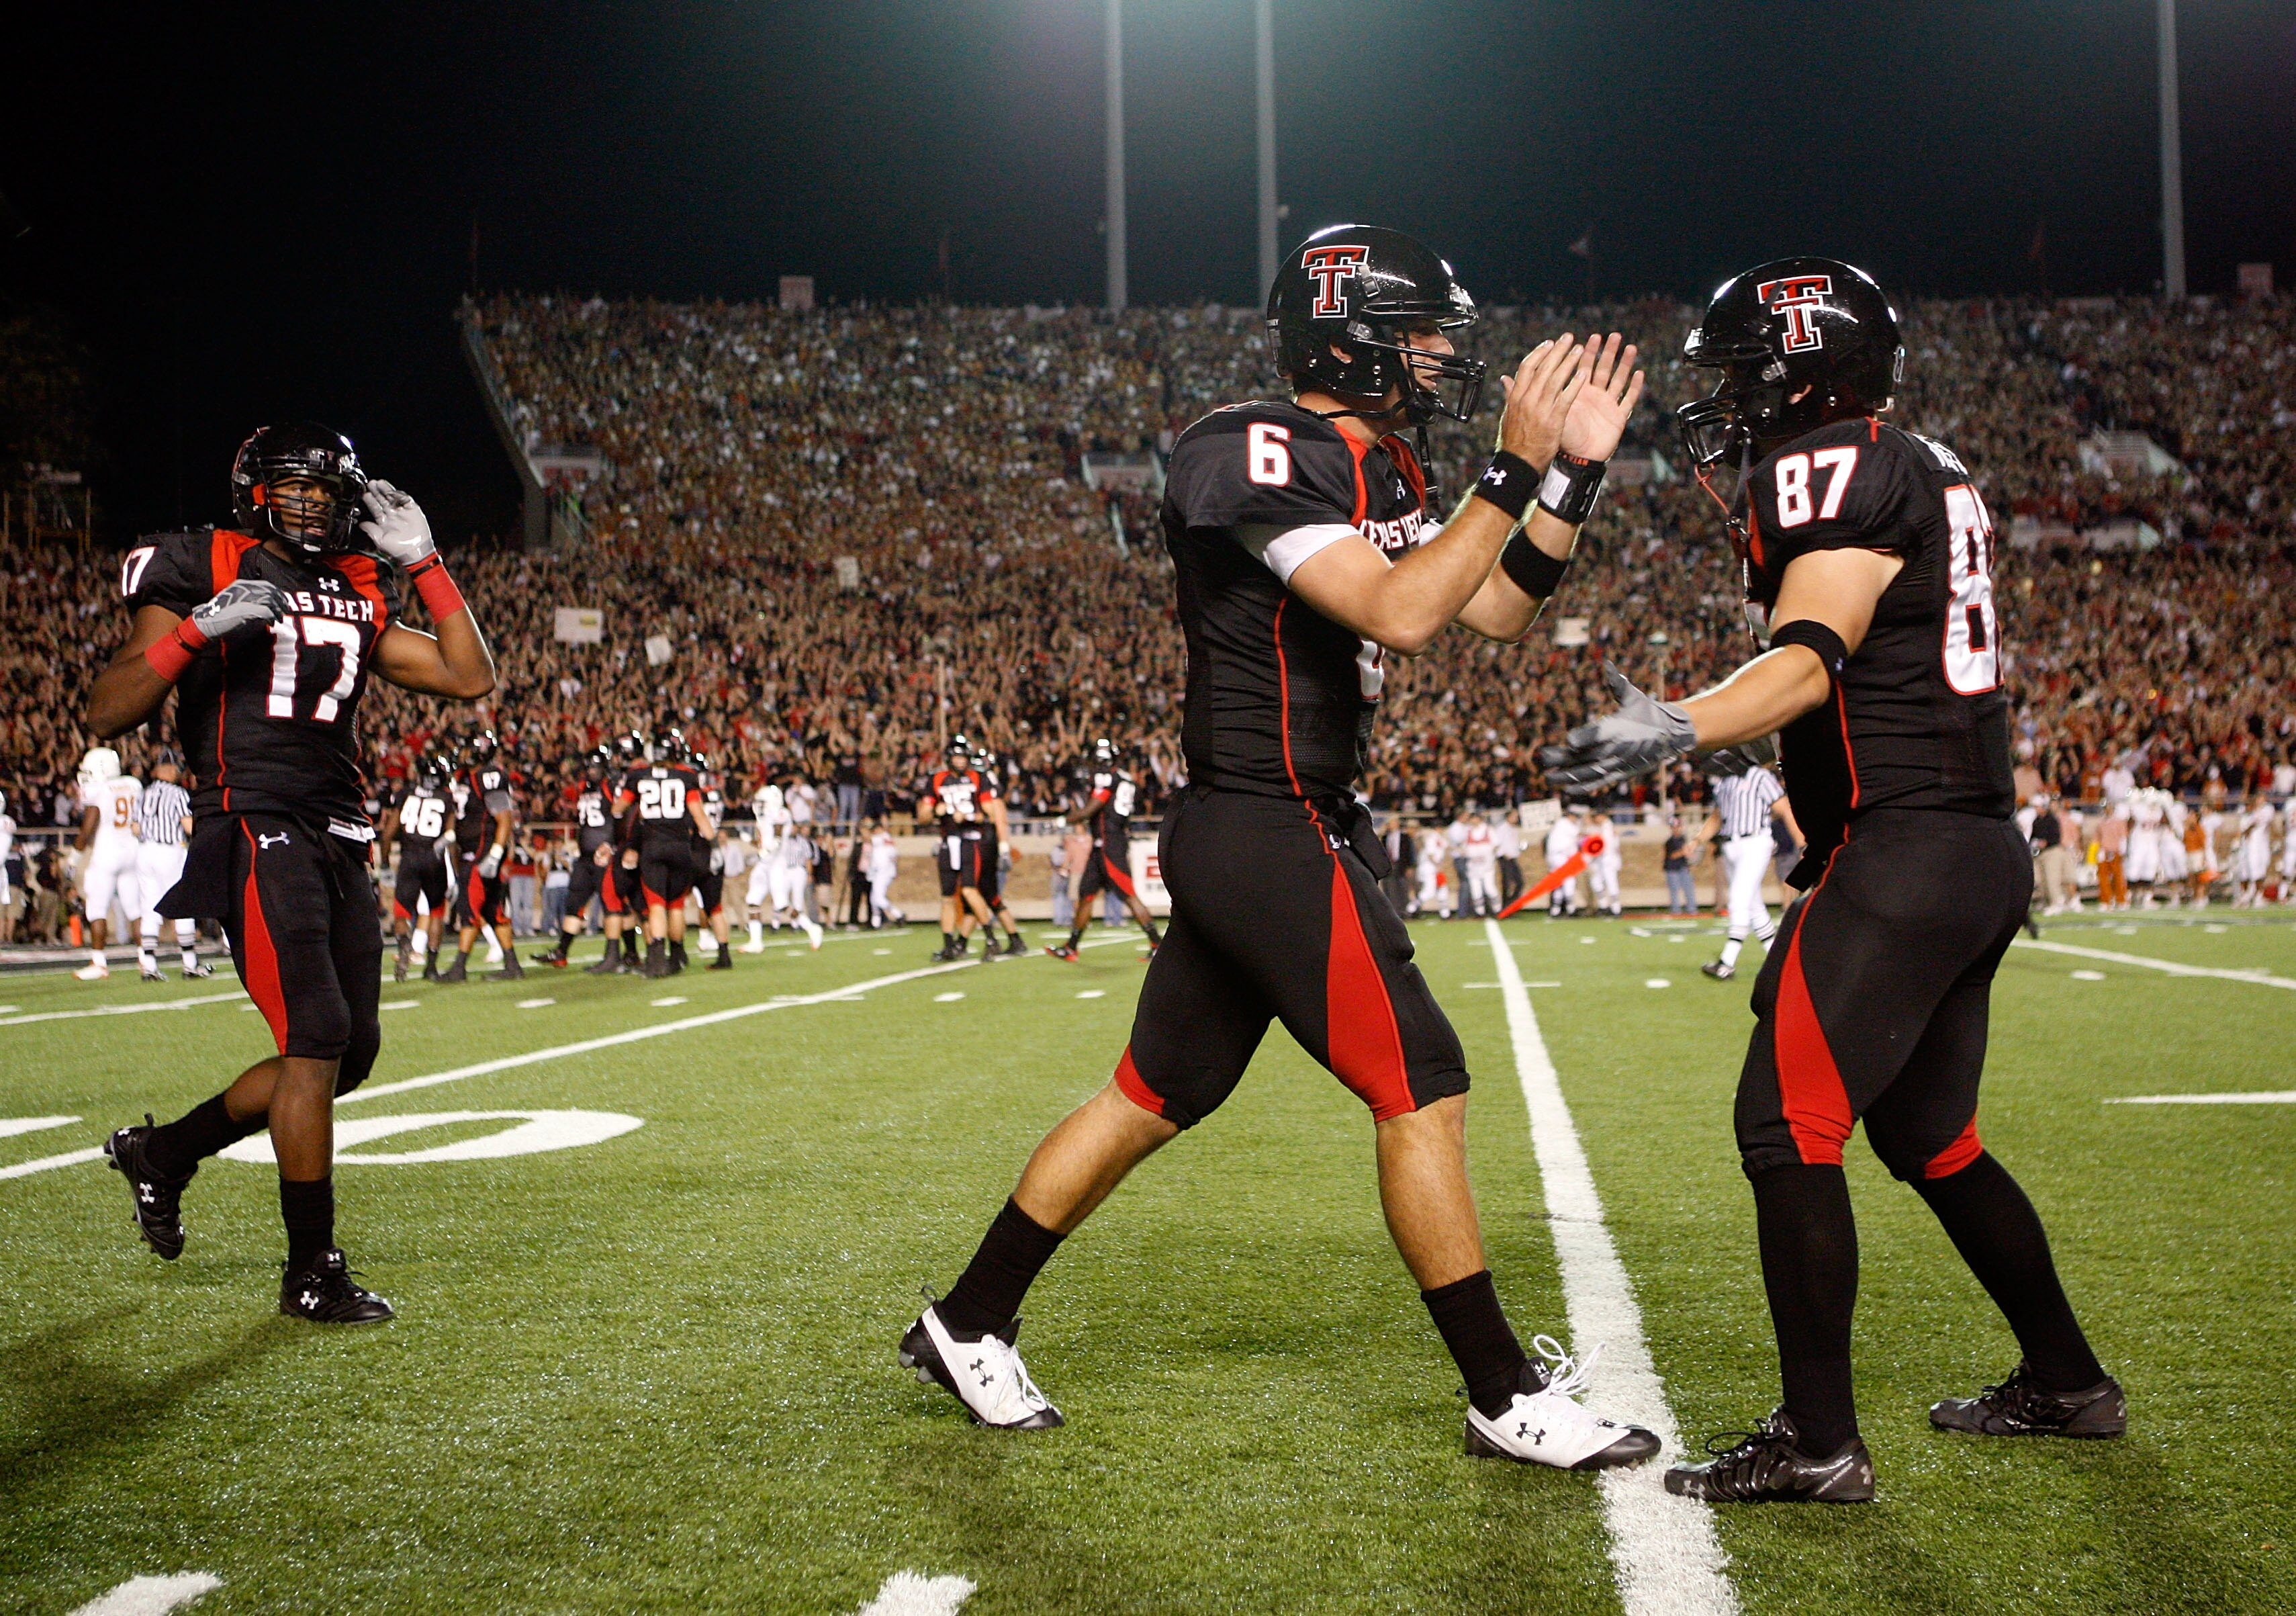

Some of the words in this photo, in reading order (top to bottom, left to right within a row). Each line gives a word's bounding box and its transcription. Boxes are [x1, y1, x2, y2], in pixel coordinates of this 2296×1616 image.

[1247, 422, 1292, 487] 6
[1774, 445, 1859, 529] 87
[318, 594, 373, 621] TECH
[267, 615, 361, 723] 17
[400, 795, 445, 838] 46
[637, 778, 685, 819] 20
